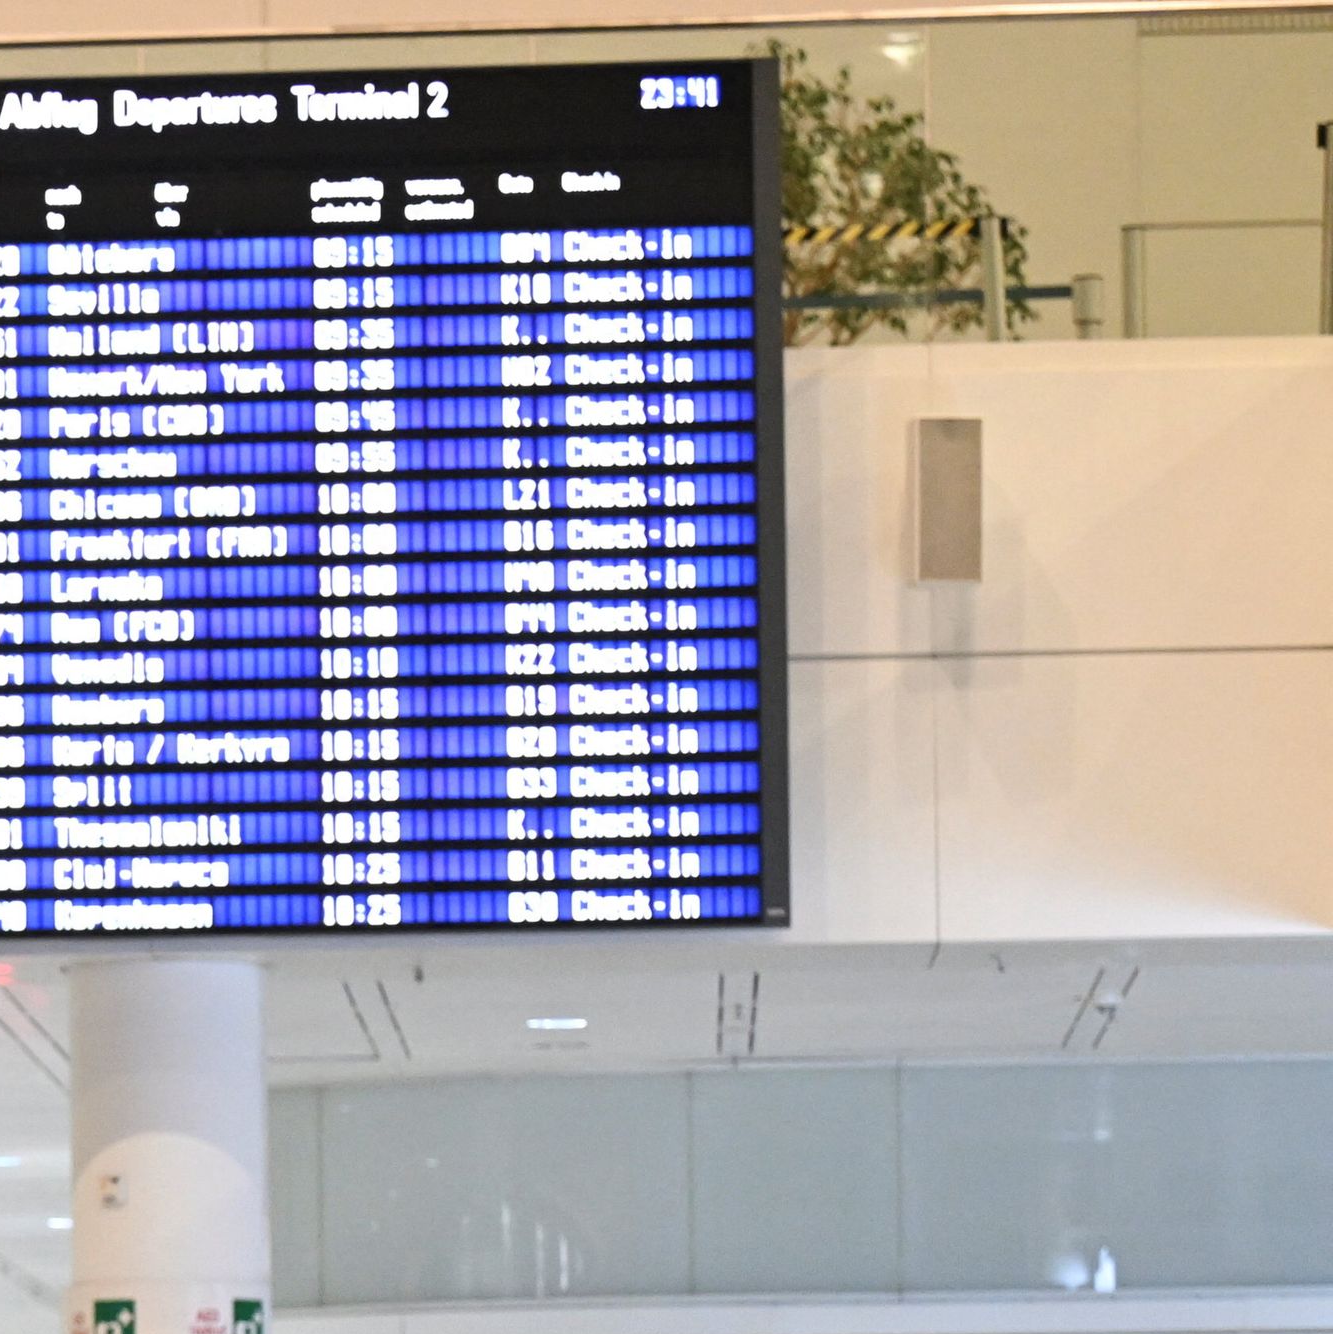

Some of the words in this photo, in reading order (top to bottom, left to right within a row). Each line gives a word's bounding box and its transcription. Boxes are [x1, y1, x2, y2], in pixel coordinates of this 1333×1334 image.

[0, 92, 97, 134] Abflug
[114, 90, 277, 132] Departures
[291, 83, 419, 121] Terminal
[427, 82, 448, 117] 2
[640, 78, 718, 109] 23:41
[48, 324, 160, 356] Mailand
[565, 312, 693, 344] Check-in
[570, 765, 698, 797] Check-in
